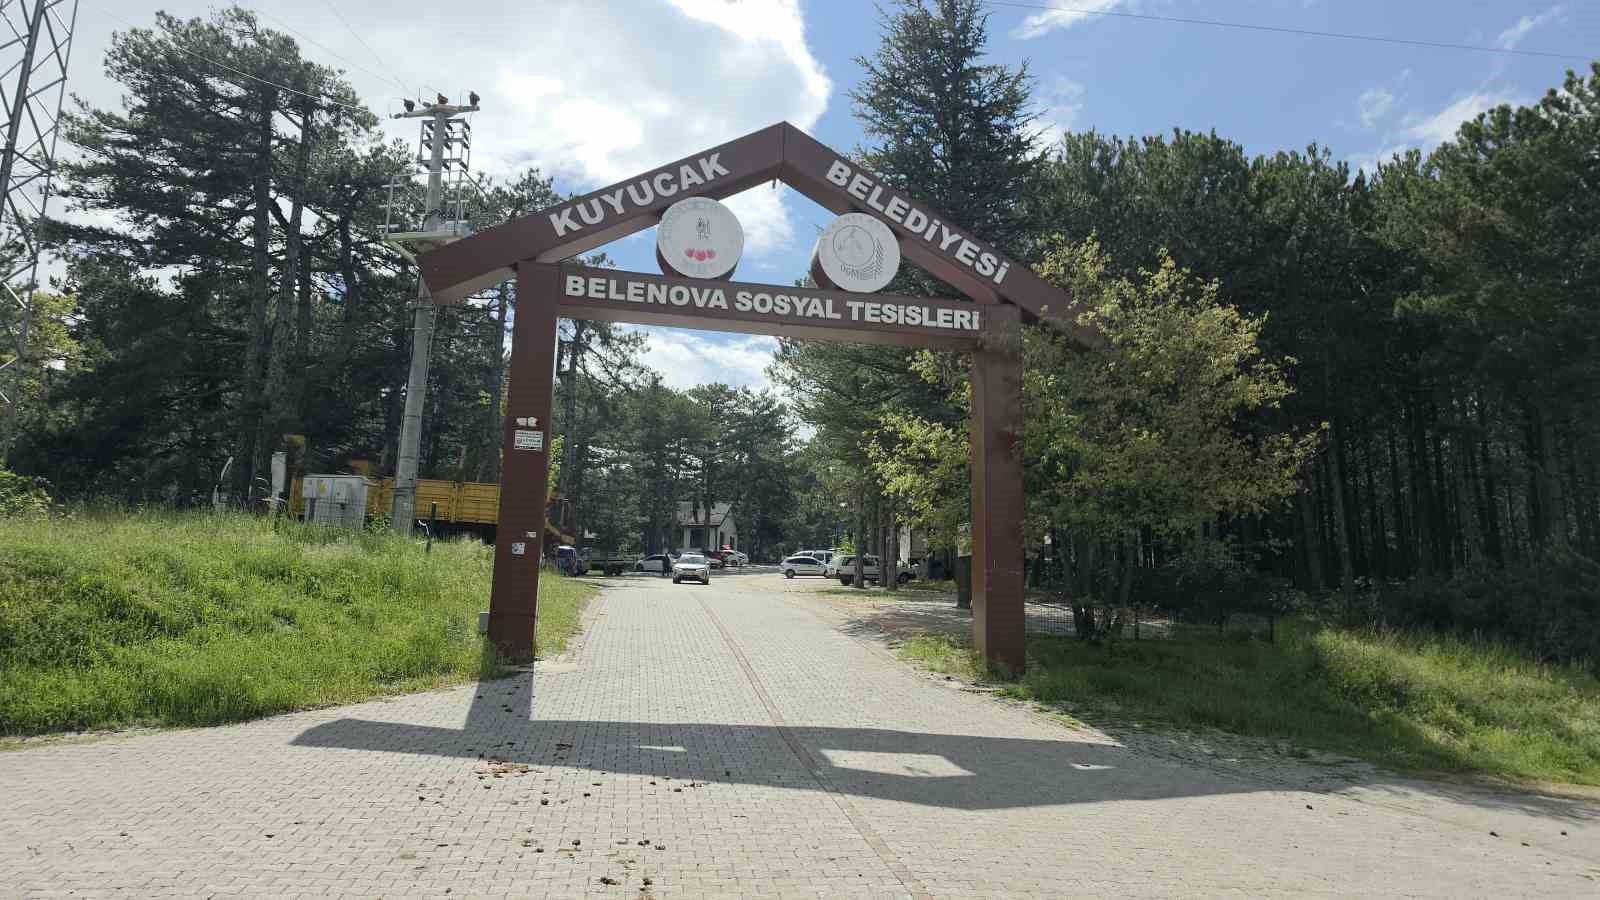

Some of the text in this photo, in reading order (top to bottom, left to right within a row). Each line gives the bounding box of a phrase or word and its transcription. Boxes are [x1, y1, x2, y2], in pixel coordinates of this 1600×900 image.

[549, 153, 730, 237] KUYUCAK
[565, 275, 729, 310] BELENOVA
[735, 291, 842, 319] SOSYAL
